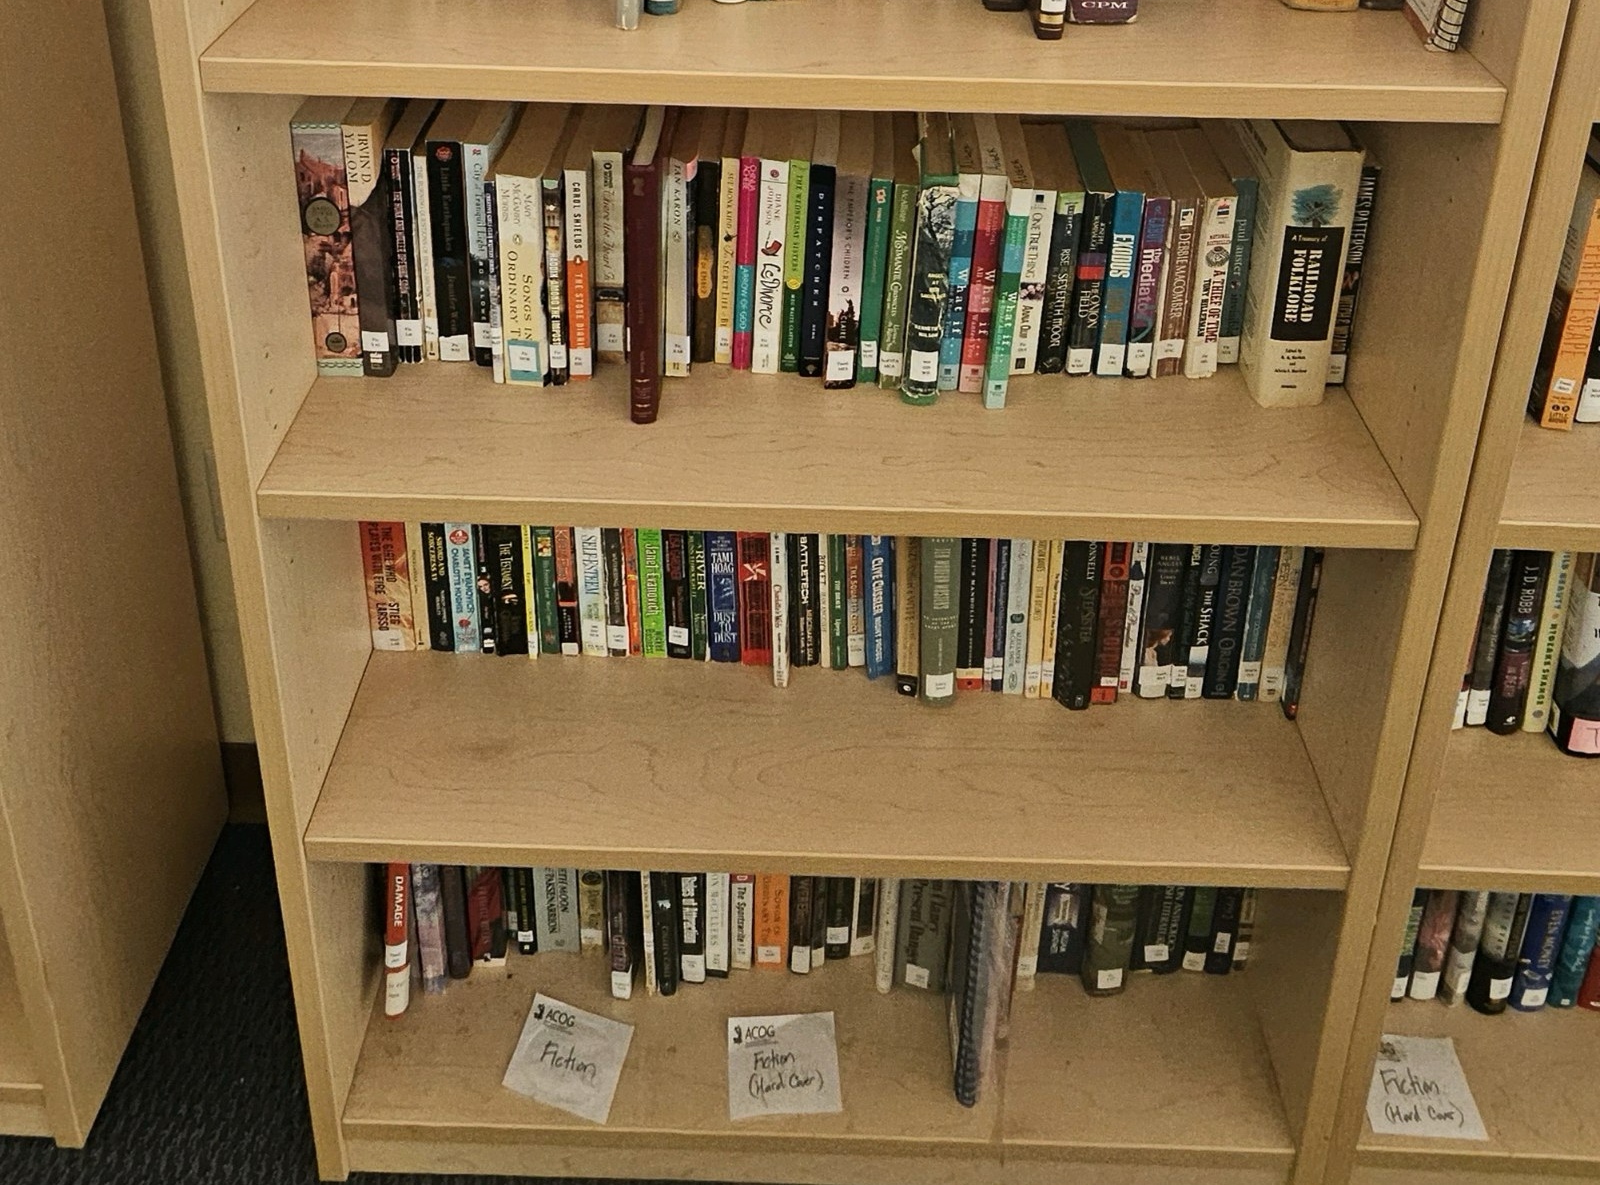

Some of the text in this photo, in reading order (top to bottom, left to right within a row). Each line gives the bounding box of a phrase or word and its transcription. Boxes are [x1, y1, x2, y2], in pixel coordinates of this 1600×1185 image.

[1081, 1, 1129, 9] CPM
[345, 133, 358, 183] YALOM
[357, 133, 370, 169] IRVIN
[572, 183, 583, 249] CAROL SHIELDS
[673, 189, 681, 226] KARON
[1109, 233, 1135, 278] EXODUS
[1170, 231, 1191, 319] DEBBIE MACOMBER
[508, 251, 519, 323] ORDINARY
[522, 275, 533, 321] SONGS
[574, 273, 584, 318] THE STONE
[1211, 278, 1225, 302] THIEF
[1284, 249, 1307, 323] FOLKLORE
[1300, 249, 1323, 323] RAILROAD
[1205, 319, 1220, 343] TIME
[696, 550, 706, 590] RIVER
[711, 553, 734, 564] TAMI
[711, 563, 735, 574] HOAG
[800, 536, 810, 605] BATTLETECH
[645, 544, 661, 617] Janet Evanovich
[872, 557, 884, 616] CLIVE CUSSLER
[389, 602, 400, 625] STIEG
[713, 612, 737, 623] DUST
[1197, 590, 1214, 646] THE SHACK
[1223, 581, 1242, 633] BROWN
[1518, 589, 1535, 614] ROBB
[714, 632, 738, 643] DUST
[393, 875, 404, 927] DAMAGE
[546, 1009, 575, 1028] ACOG
[745, 1026, 776, 1039] ACOG
[540, 1041, 597, 1080] Fiction
[753, 1051, 796, 1072] Fiction
[1379, 1067, 1441, 1096] Fiction
